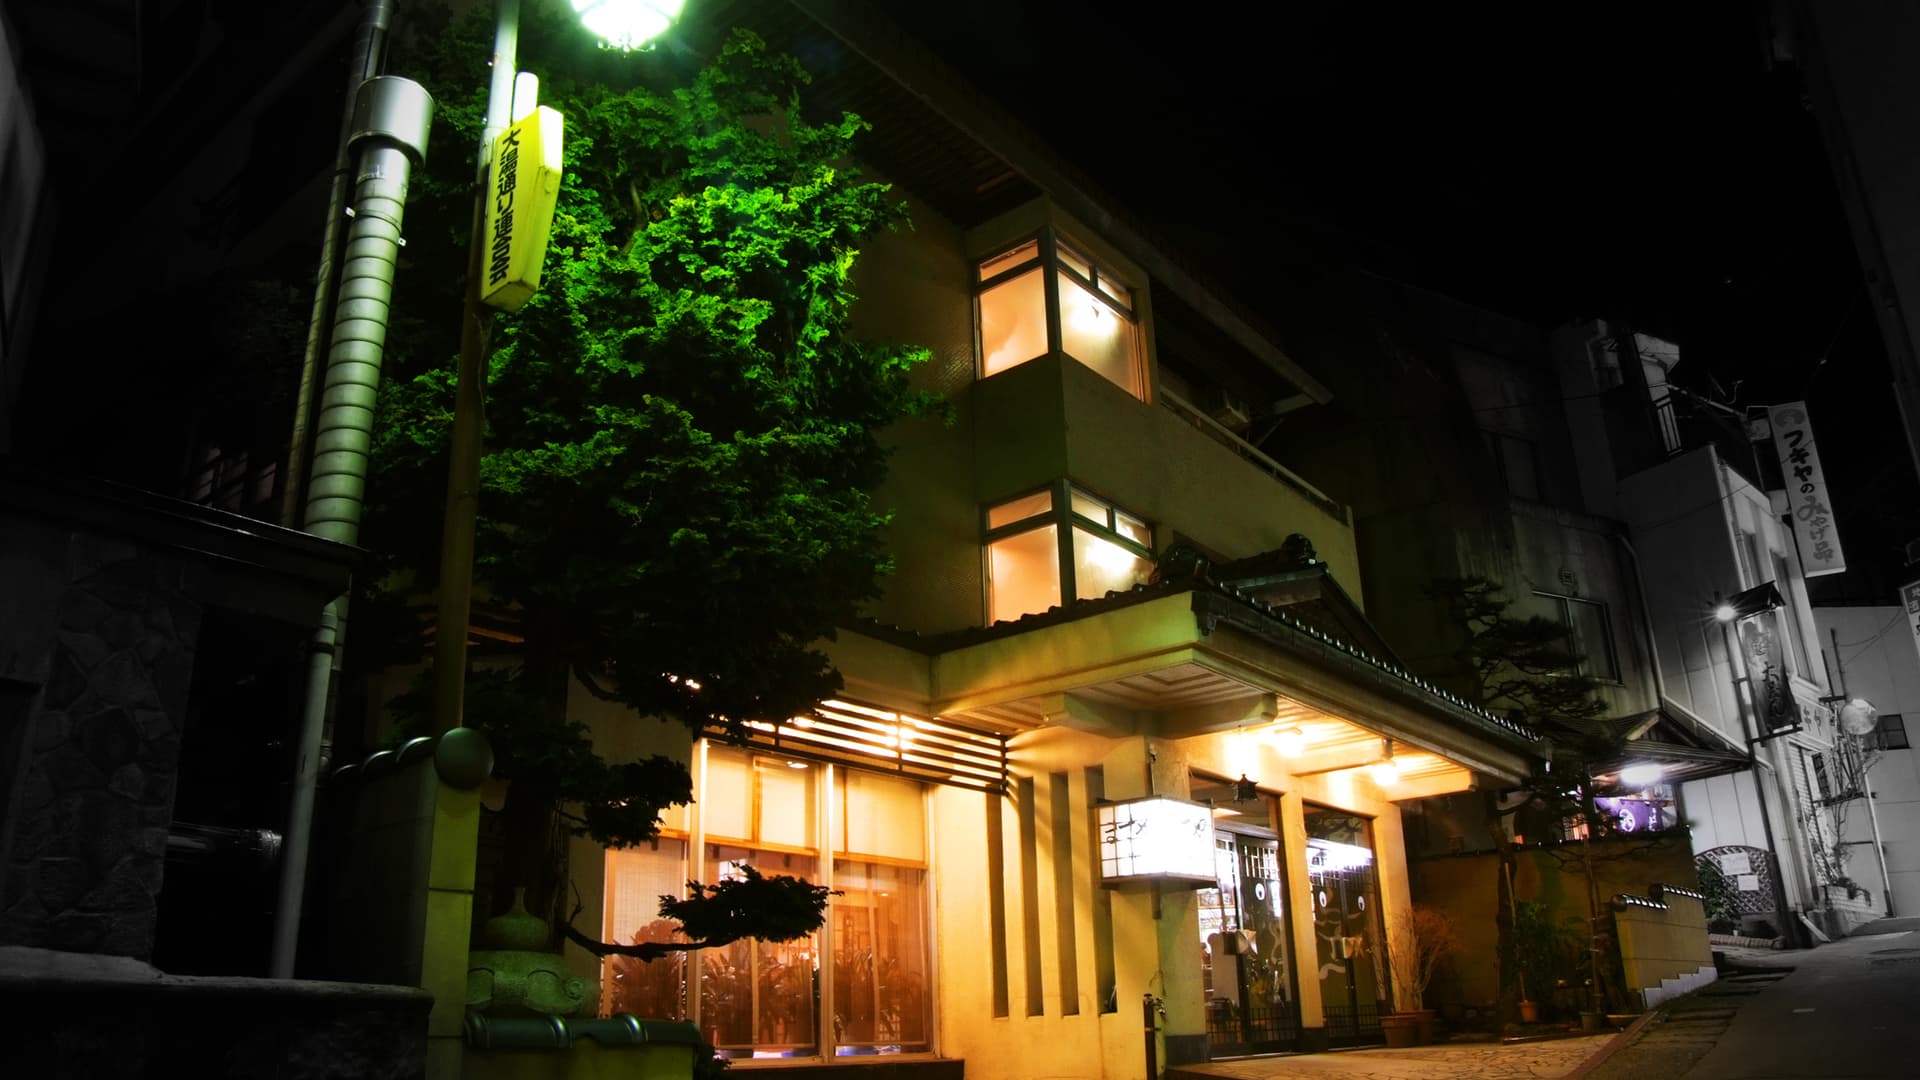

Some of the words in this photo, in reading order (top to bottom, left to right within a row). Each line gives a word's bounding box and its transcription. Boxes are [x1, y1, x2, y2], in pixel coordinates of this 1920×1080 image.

[489, 128, 522, 286] 大湯通り連合会
